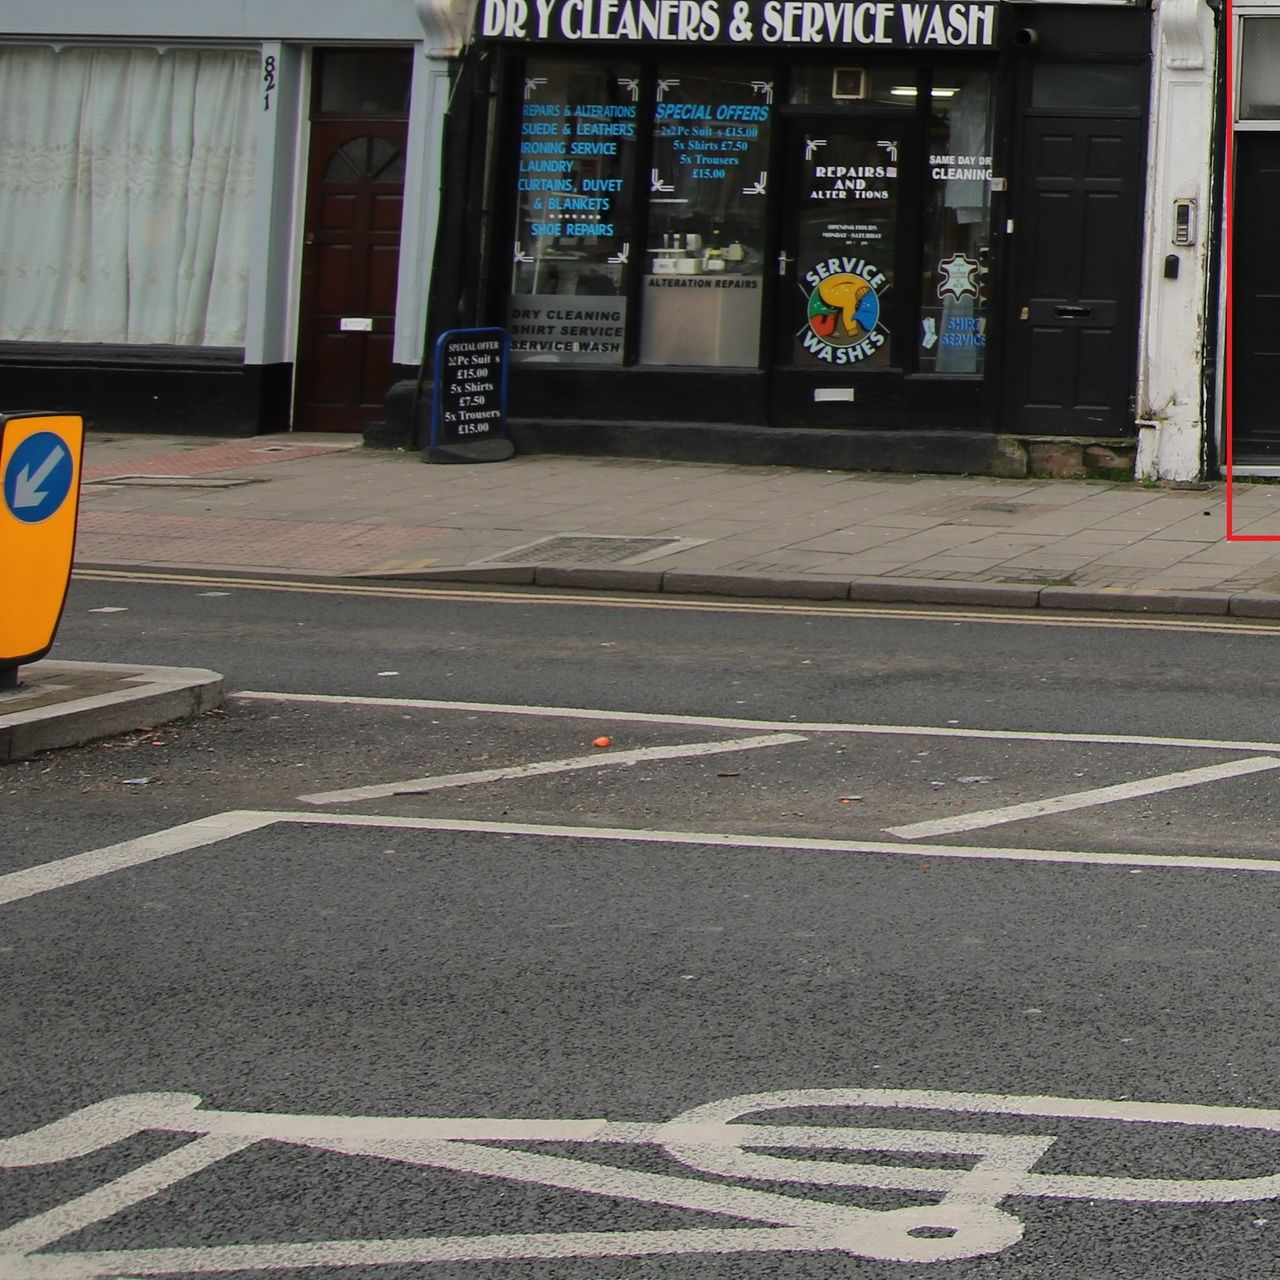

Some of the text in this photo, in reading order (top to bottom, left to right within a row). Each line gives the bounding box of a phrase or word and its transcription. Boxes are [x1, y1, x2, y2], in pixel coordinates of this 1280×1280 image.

[729, 1, 753, 42] &
[762, 1, 894, 43] SERVICE
[902, 3, 994, 46] WASH
[522, 104, 636, 118] REPAIRS & ALTERATIONS
[655, 103, 769, 121] SPECIAL OFFERS
[521, 123, 634, 136] SUEDE & LEATHERS
[725, 127, 758, 138] £15.00
[521, 142, 617, 155] IRONING SERVICE
[672, 140, 748, 152] 5x Shirts £7.50
[680, 154, 739, 165] 5x Trousers
[929, 155, 955, 165] SAME
[957, 155, 976, 165] DAY
[520, 160, 574, 172] LAUNDRY
[816, 166, 885, 178] REPAIRS
[692, 169, 726, 179] £15.00
[518, 179, 623, 193] CURTAINS, DUVET
[834, 179, 866, 190] AND
[533, 198, 610, 210] & BLANKETS
[531, 223, 614, 237] SHOE REPAIRS
[805, 256, 886, 289] SERVICE
[648, 278, 758, 289] ALTERATION REPAIRS
[512, 309, 621, 321] DRY CLEANING
[948, 317, 981, 330] SHIRT
[511, 324, 623, 337] SHIRT SERVICE
[942, 333, 985, 346] SERVICE
[448, 341, 499, 352] SPECIAL OFFER
[510, 341, 621, 353] SERVICE WASH
[802, 330, 885, 364] WASHES
[471, 354, 491, 364] Suit
[457, 368, 488, 379] £15.00
[450, 380, 493, 394] 5x Shirts
[459, 395, 485, 406] £7.50
[445, 409, 500, 421] 5x Trousers
[458, 422, 489, 434] £15.00
